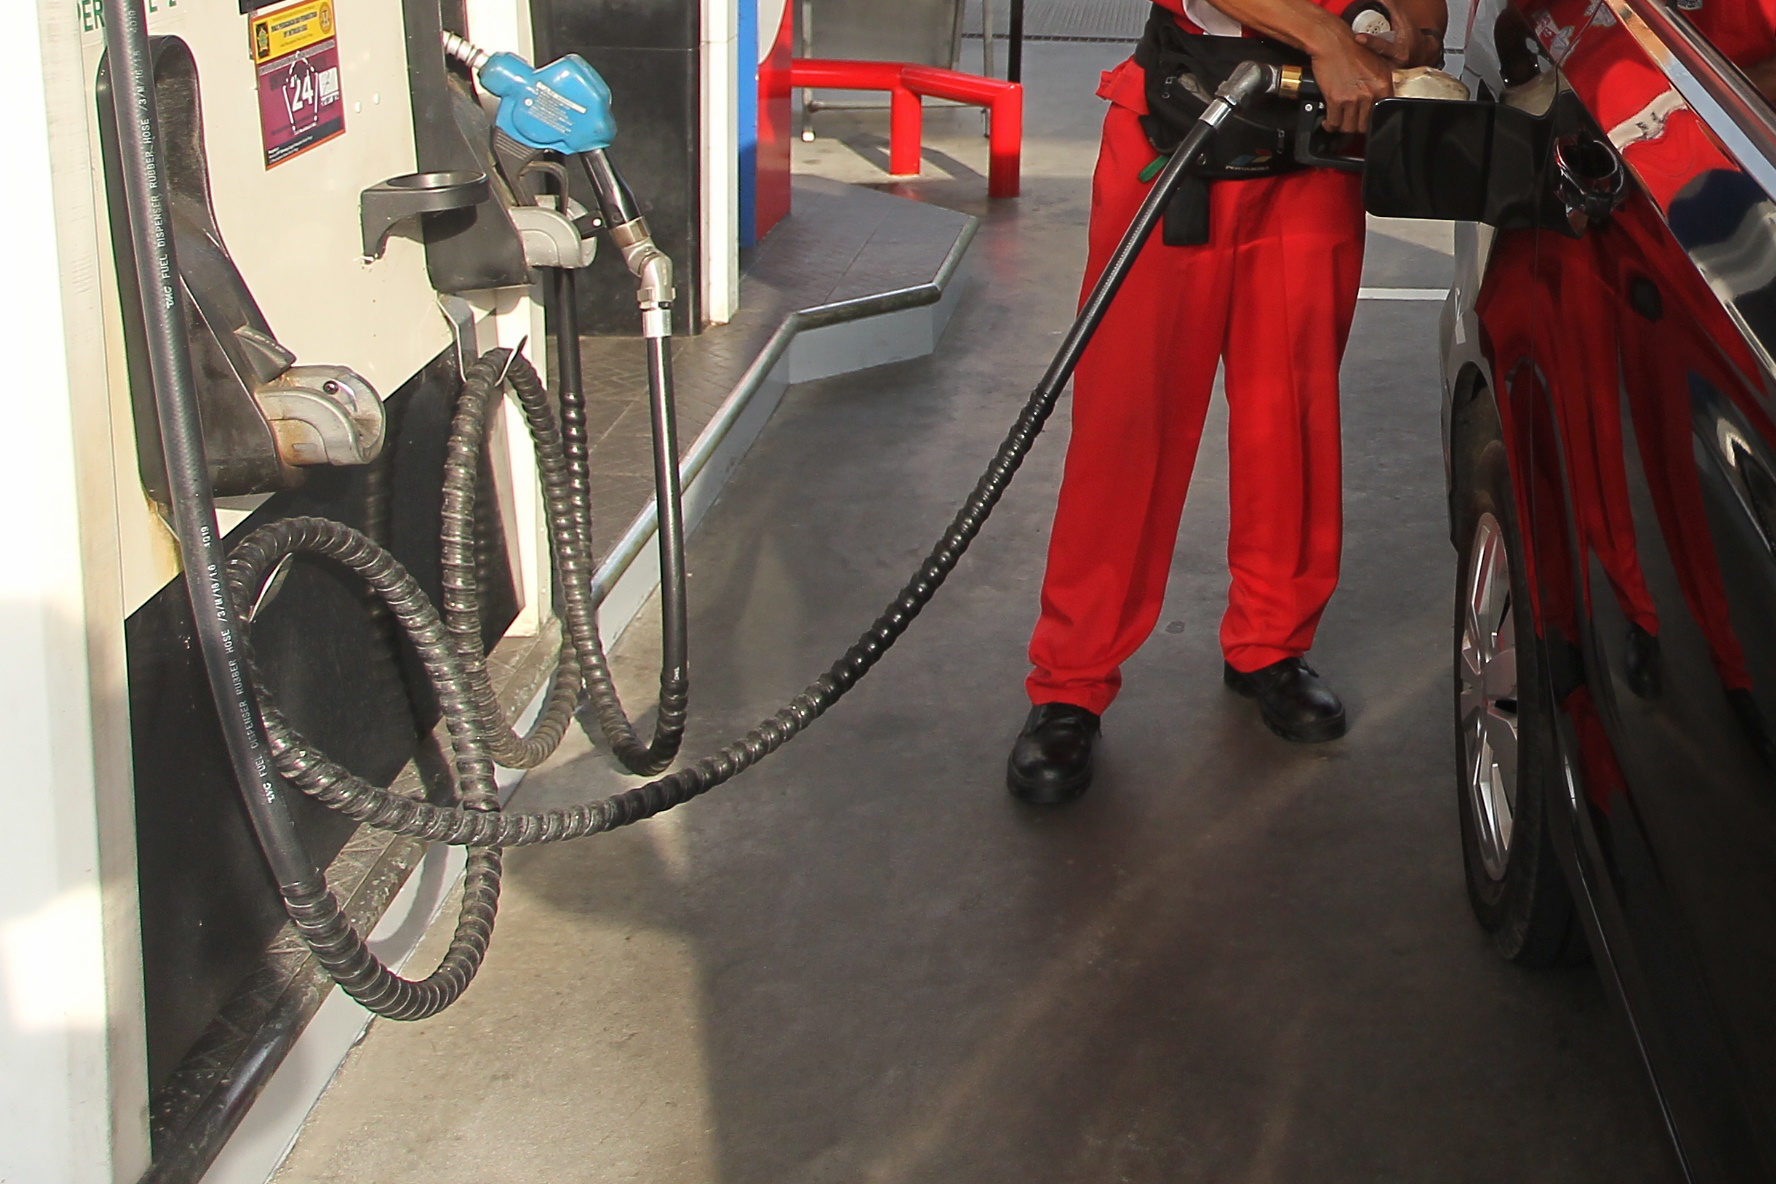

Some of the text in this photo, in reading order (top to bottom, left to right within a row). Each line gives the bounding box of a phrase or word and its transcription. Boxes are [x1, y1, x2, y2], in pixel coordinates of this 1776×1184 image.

[141, 118, 151, 145] HOSE
[148, 146, 159, 190] RUBBER
[152, 195, 166, 248] DISPENSER
[161, 253, 171, 279] FUEL
[220, 628, 234, 653] HOSE
[229, 659, 244, 696] RUBBER
[238, 699, 260, 751] DISPENSER
[254, 754, 267, 780] FUEL
